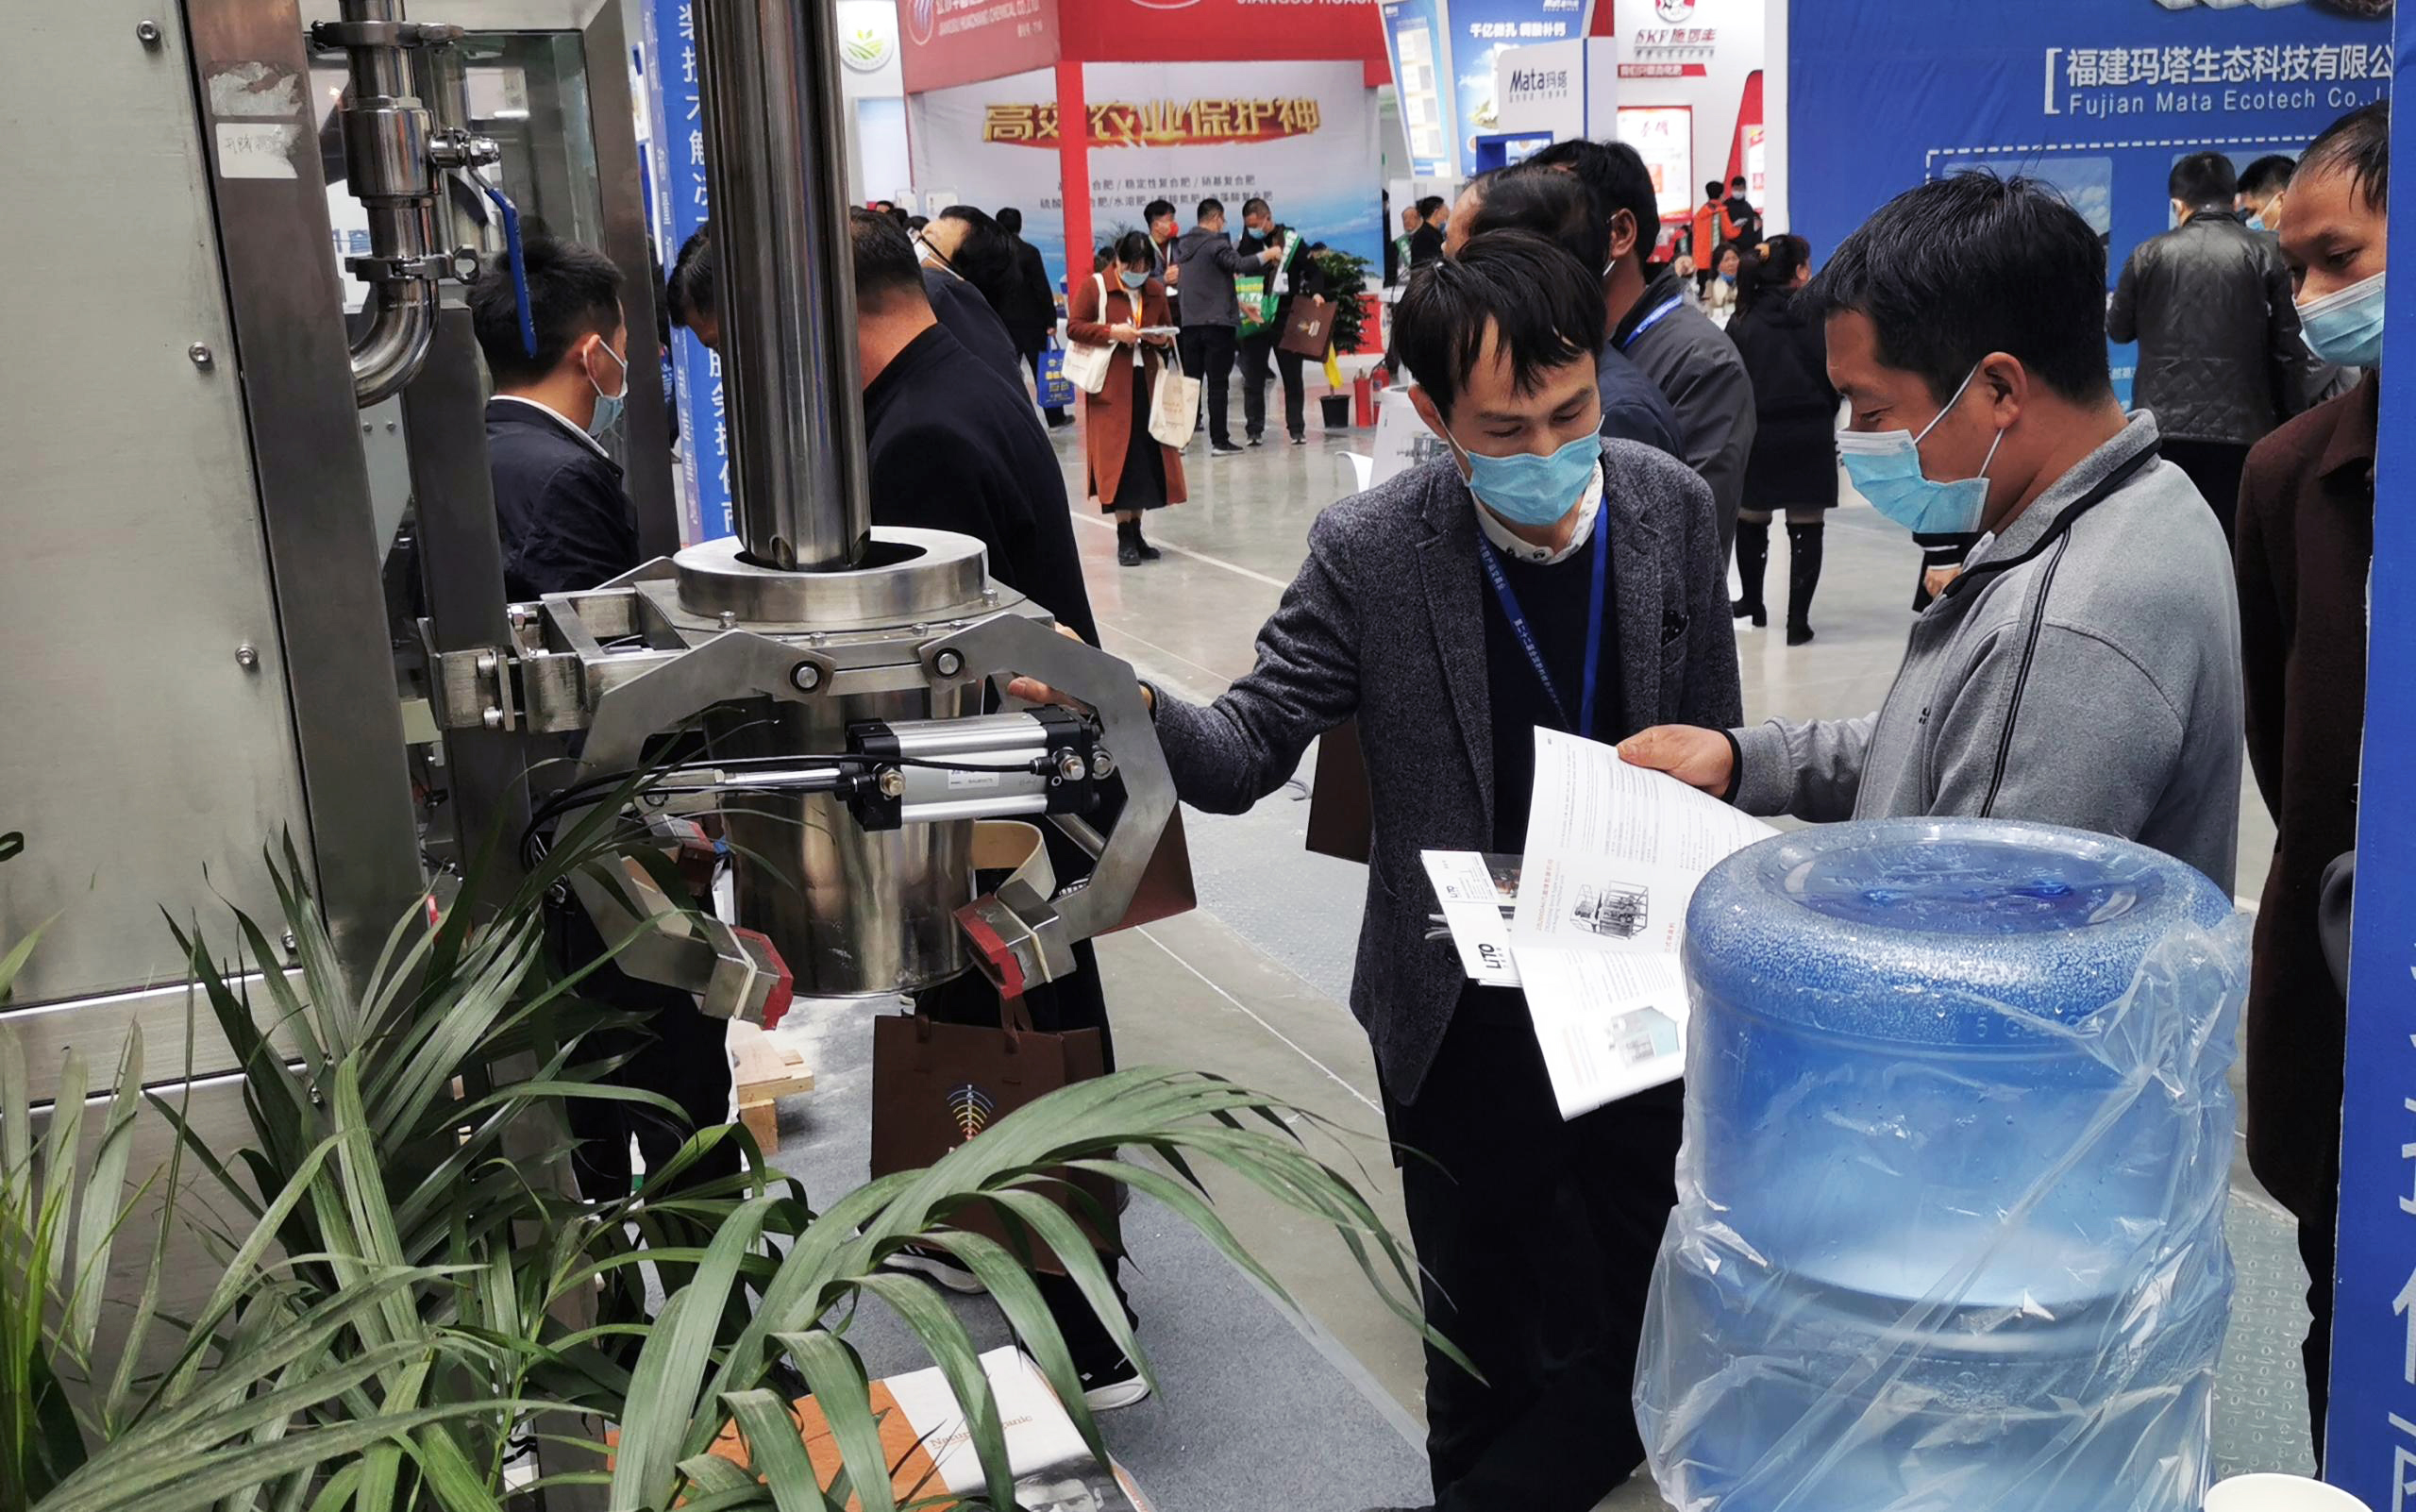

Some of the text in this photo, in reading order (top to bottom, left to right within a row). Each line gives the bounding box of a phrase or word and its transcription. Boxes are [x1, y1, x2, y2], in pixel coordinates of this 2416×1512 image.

[2070, 94, 2143, 119] Fujian
[2156, 92, 2212, 112] Mata
[2223, 90, 2315, 110] Ecotech
[1478, 944, 1503, 970] LITO
